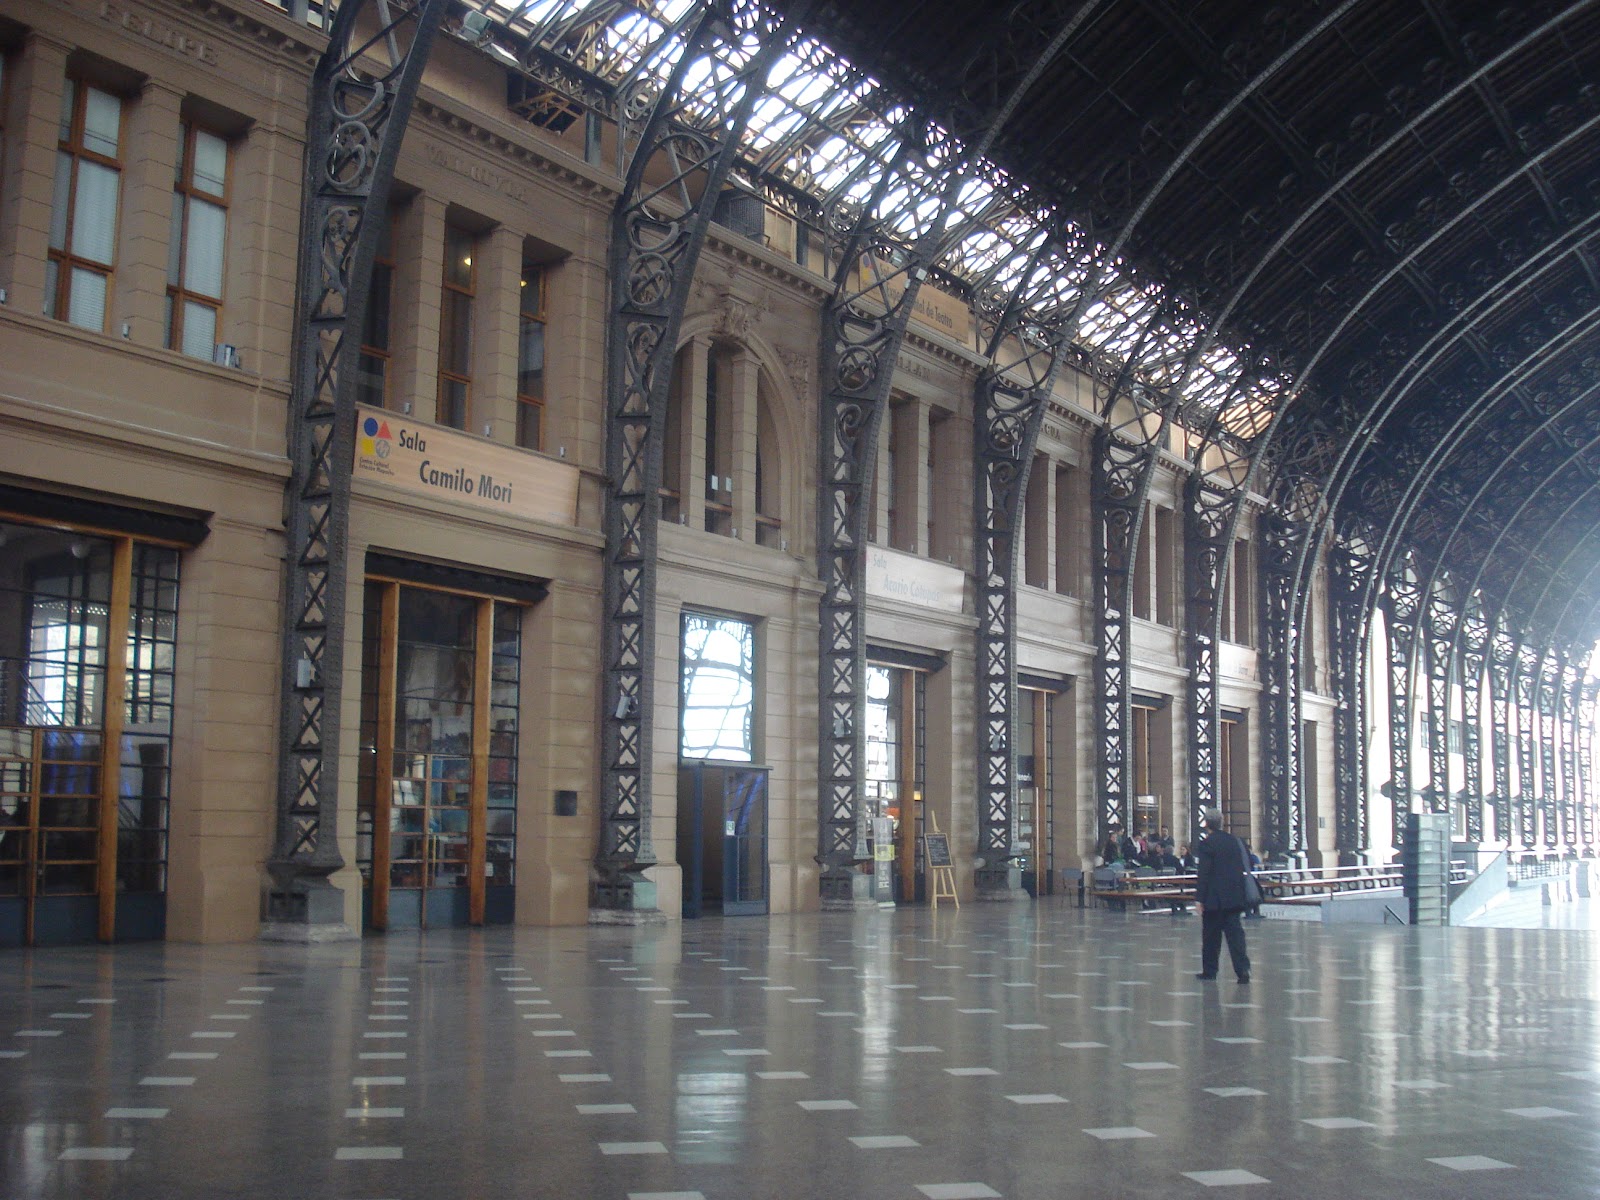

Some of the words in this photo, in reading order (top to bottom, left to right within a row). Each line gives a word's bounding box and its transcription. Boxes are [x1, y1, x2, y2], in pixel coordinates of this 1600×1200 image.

[398, 428, 426, 453] Sala
[418, 459, 474, 494] Camilo
[477, 474, 512, 504] Mori
[873, 553, 887, 569] Sala
